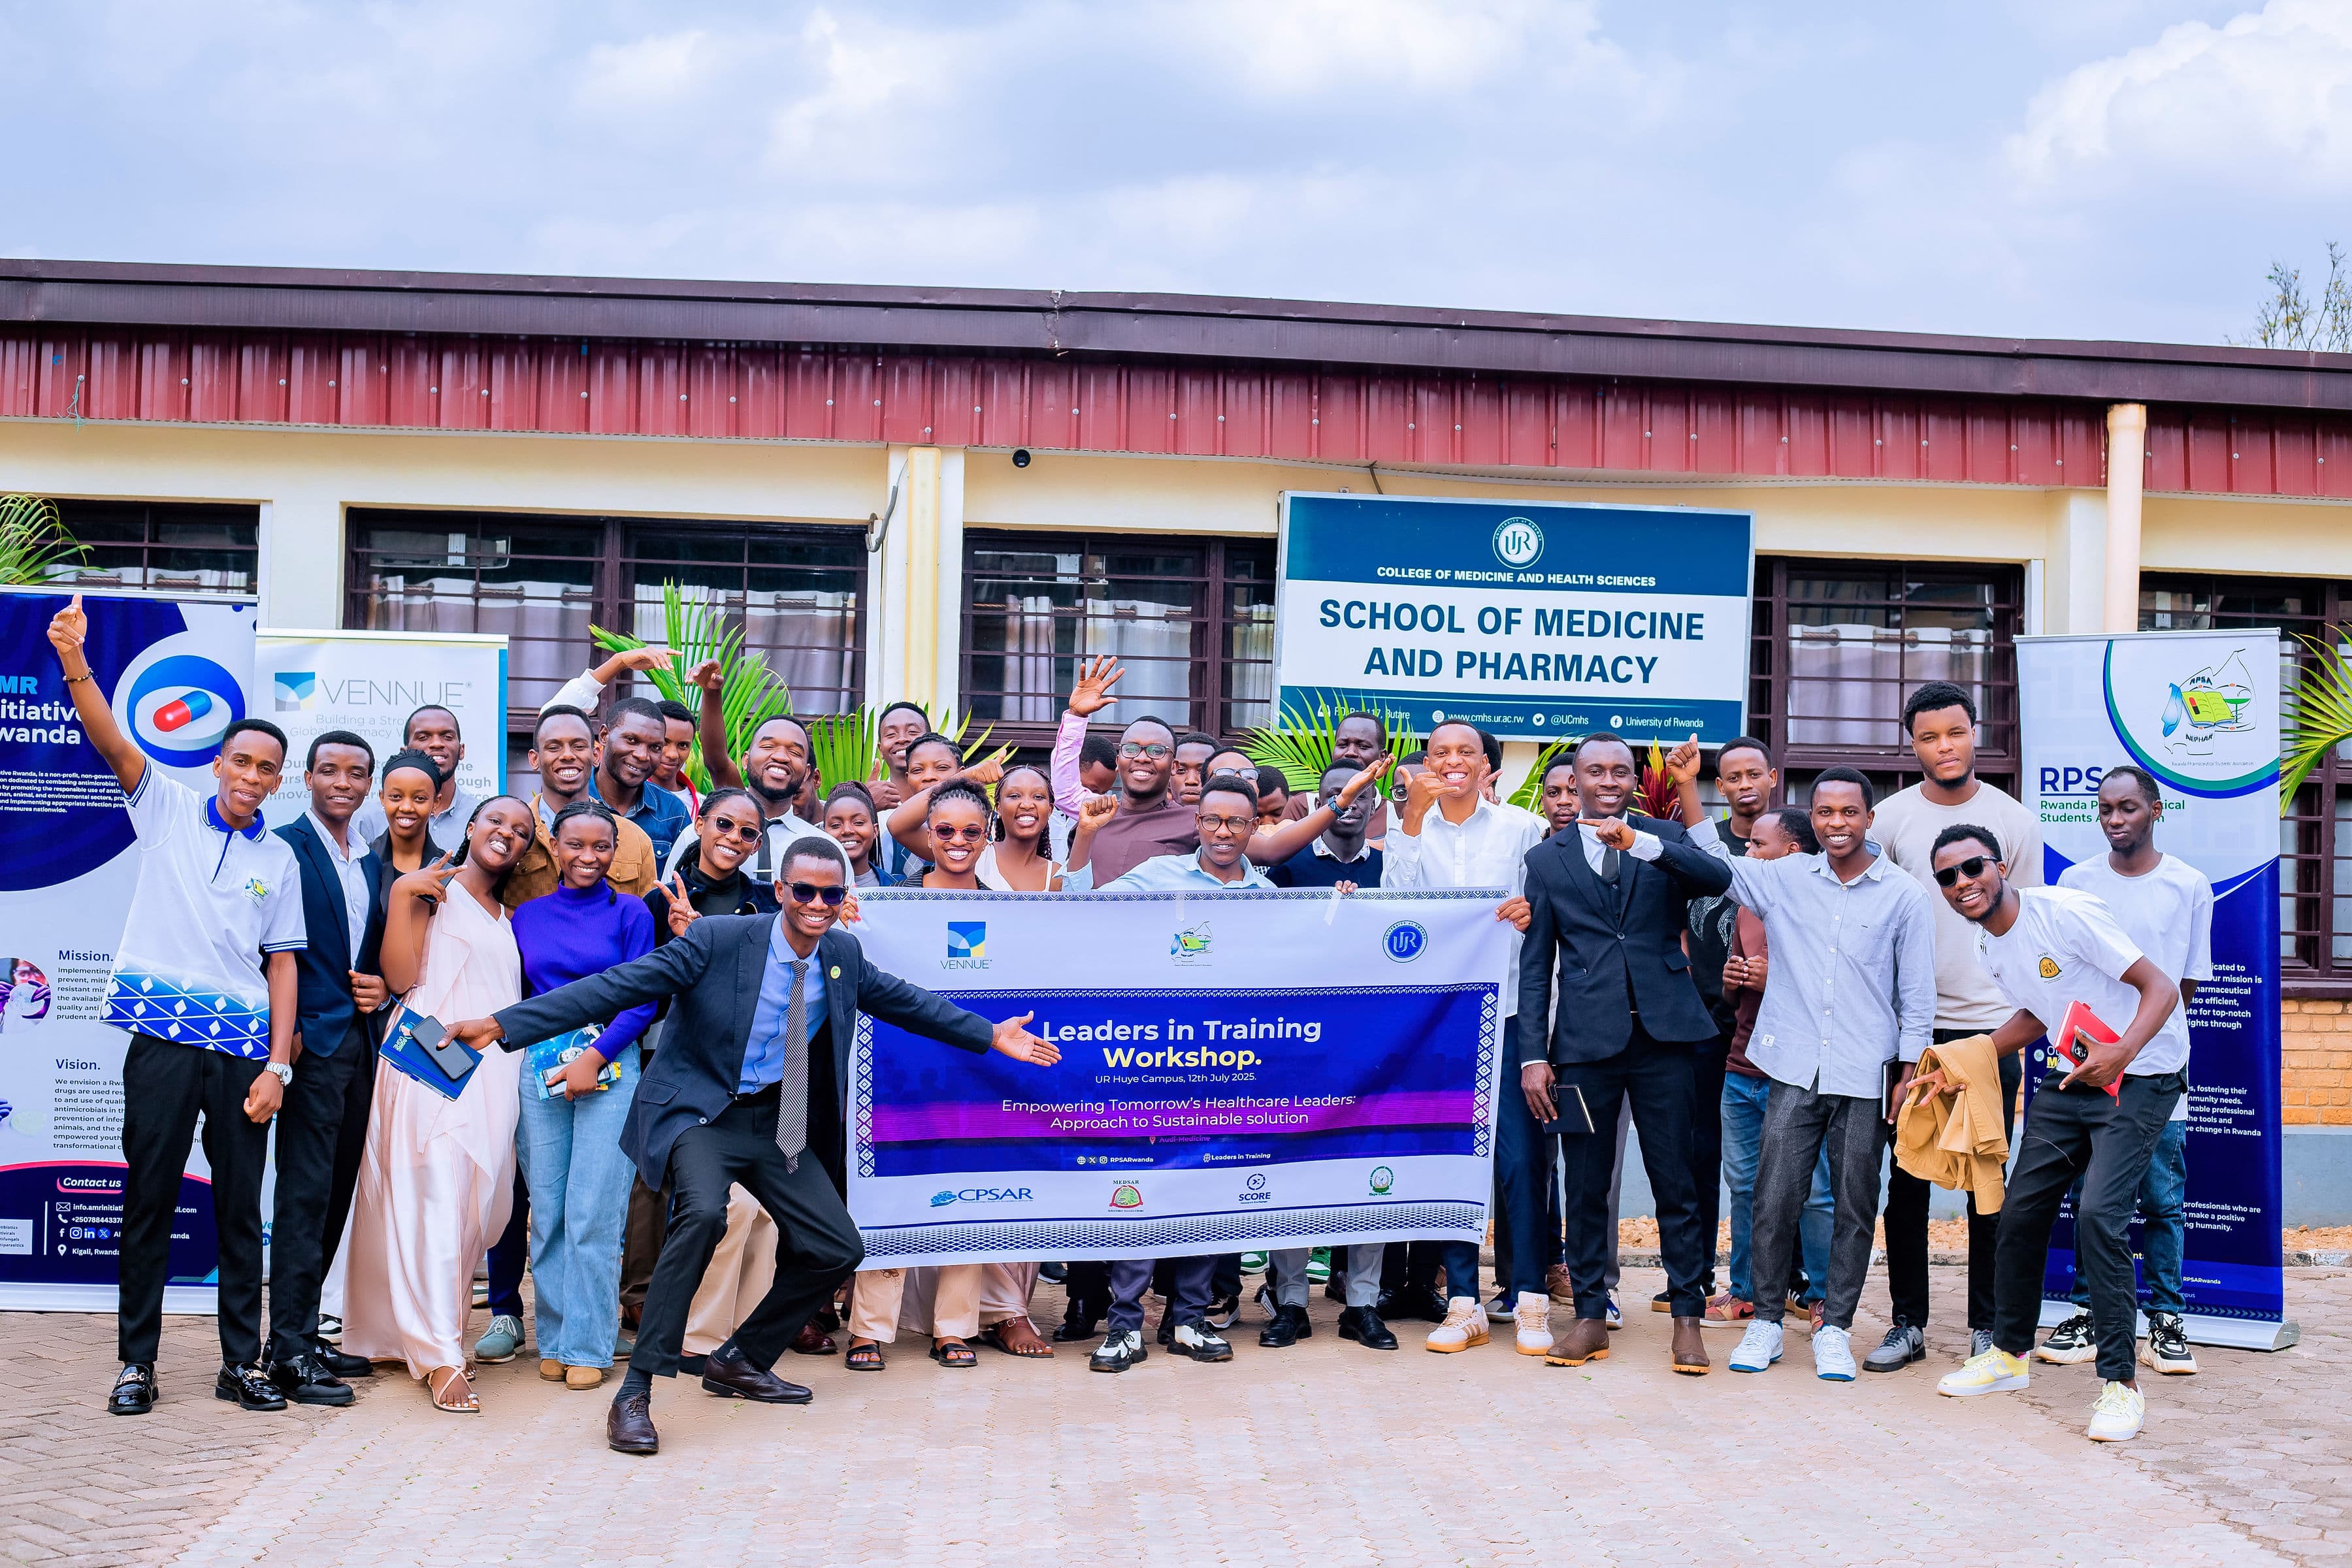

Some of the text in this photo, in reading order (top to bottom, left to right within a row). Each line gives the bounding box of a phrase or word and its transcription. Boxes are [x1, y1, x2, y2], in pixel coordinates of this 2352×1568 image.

[1377, 566, 1656, 587] COLLEGE OF MEDICINE AND HEALTH SCIENCES
[1319, 598, 1705, 641] SCHOOL OF MEDICINE
[1364, 646, 1659, 684] AND PHARMACY
[0, 676, 38, 694] MR
[1, 698, 82, 721] itiativ
[316, 714, 365, 726] Building
[380, 716, 405, 725] Stro
[1448, 712, 1524, 723] www.cmhs.ur.ac.rw
[1550, 715, 1589, 725] @UCmhs
[1626, 716, 1703, 728] University of Rwanda
[0, 725, 80, 744] wanda
[457, 777, 491, 789] ough
[2040, 766, 2103, 792] RPS
[2040, 800, 2087, 809] Rwanda
[2040, 813, 2092, 823] Students
[59, 950, 113, 961] Mission.
[58, 967, 111, 975] Implementing
[2212, 962, 2235, 971] icated
[2223, 975, 2253, 983] mission
[2205, 997, 2239, 1007] efficient,
[2212, 1009, 2251, 1018] top-notch
[1043, 1017, 1321, 1042] Leaders in Training
[2210, 1020, 2242, 1030] through
[1103, 1047, 1262, 1070] Workshop.
[56, 1059, 101, 1070] Vision.
[1096, 1073, 1257, 1085] UR Huye Campus, 12th July 2025.
[2197, 1085, 2229, 1094] fostering
[1002, 1094, 1356, 1115] Empowering Tomorrow's Healthcare Leaders:
[2212, 1107, 2255, 1115] professional
[1051, 1111, 1309, 1131] Approach to Sustainable solution
[2195, 1126, 2222, 1134] change
[2232, 1128, 2261, 1136] Rwanda
[63, 1177, 106, 1187] Contact
[958, 1188, 1034, 1201] CPSAR
[1239, 1192, 1271, 1201] SCORE
[2183, 1201, 2230, 1211] professionals
[2217, 1213, 2246, 1222] positive
[2195, 1222, 2232, 1232] humanity.
[2183, 1276, 2221, 1284] RPSARwanda
